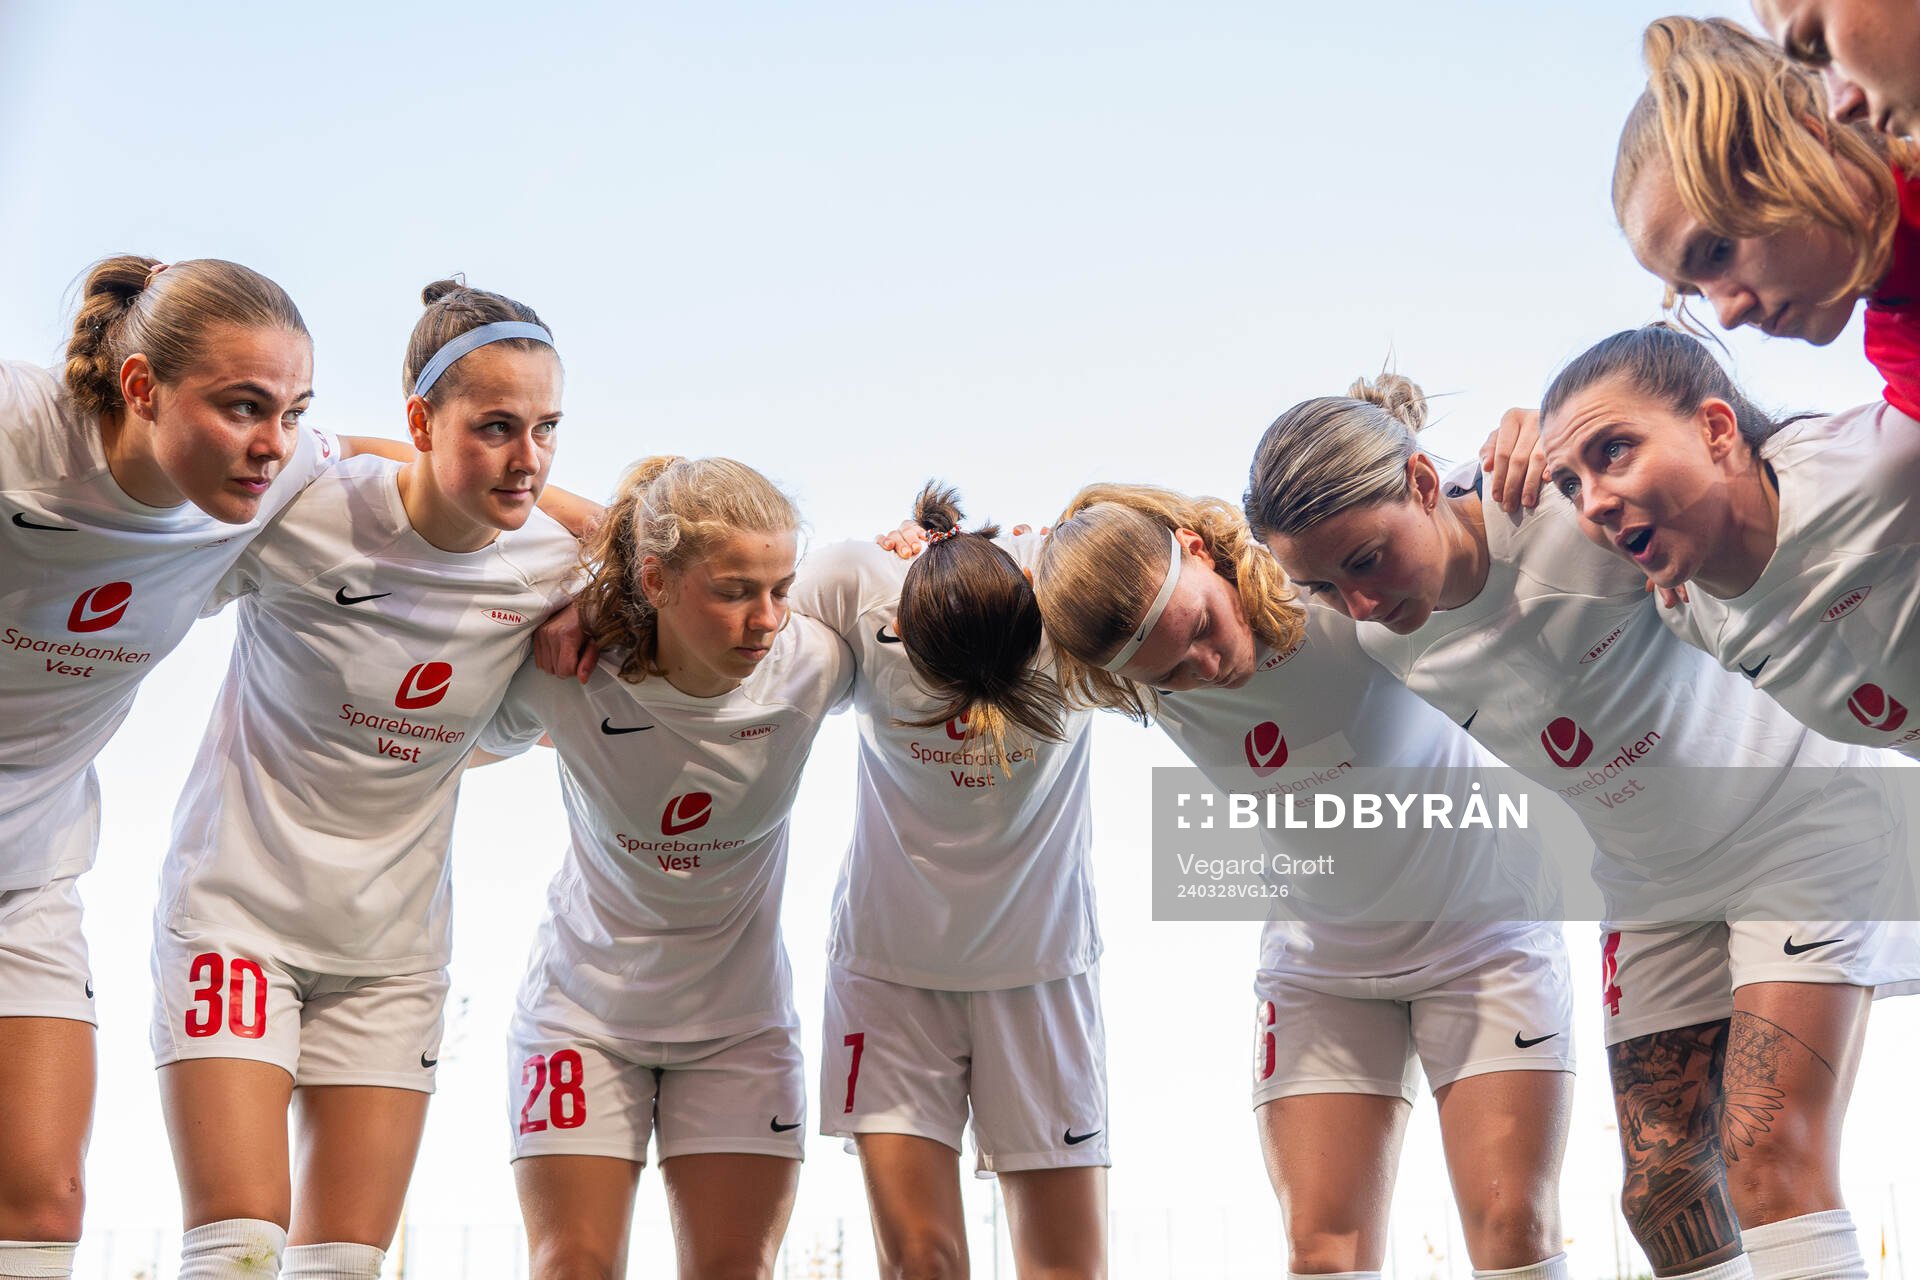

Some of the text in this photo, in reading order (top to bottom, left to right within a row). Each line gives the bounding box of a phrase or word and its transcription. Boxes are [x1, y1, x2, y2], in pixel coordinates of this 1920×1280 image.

[490, 610, 522, 624] BRANN
[1828, 590, 1862, 619] BRANN
[1, 628, 150, 664] Sparebanken
[1589, 628, 1622, 659] BRANN
[46, 658, 95, 678] Vest
[339, 703, 465, 744] Sparebanken
[740, 726, 772, 738] BRANN
[377, 737, 421, 763] Vest
[1558, 731, 1661, 798] parebanken
[951, 770, 995, 788] Vest
[1594, 779, 1646, 809] Vest
[616, 833, 746, 853] Sparebanken
[657, 854, 700, 872] Vest
[185, 952, 267, 1039] 30
[843, 1032, 865, 1114] 7
[520, 1048, 587, 1136] 28
